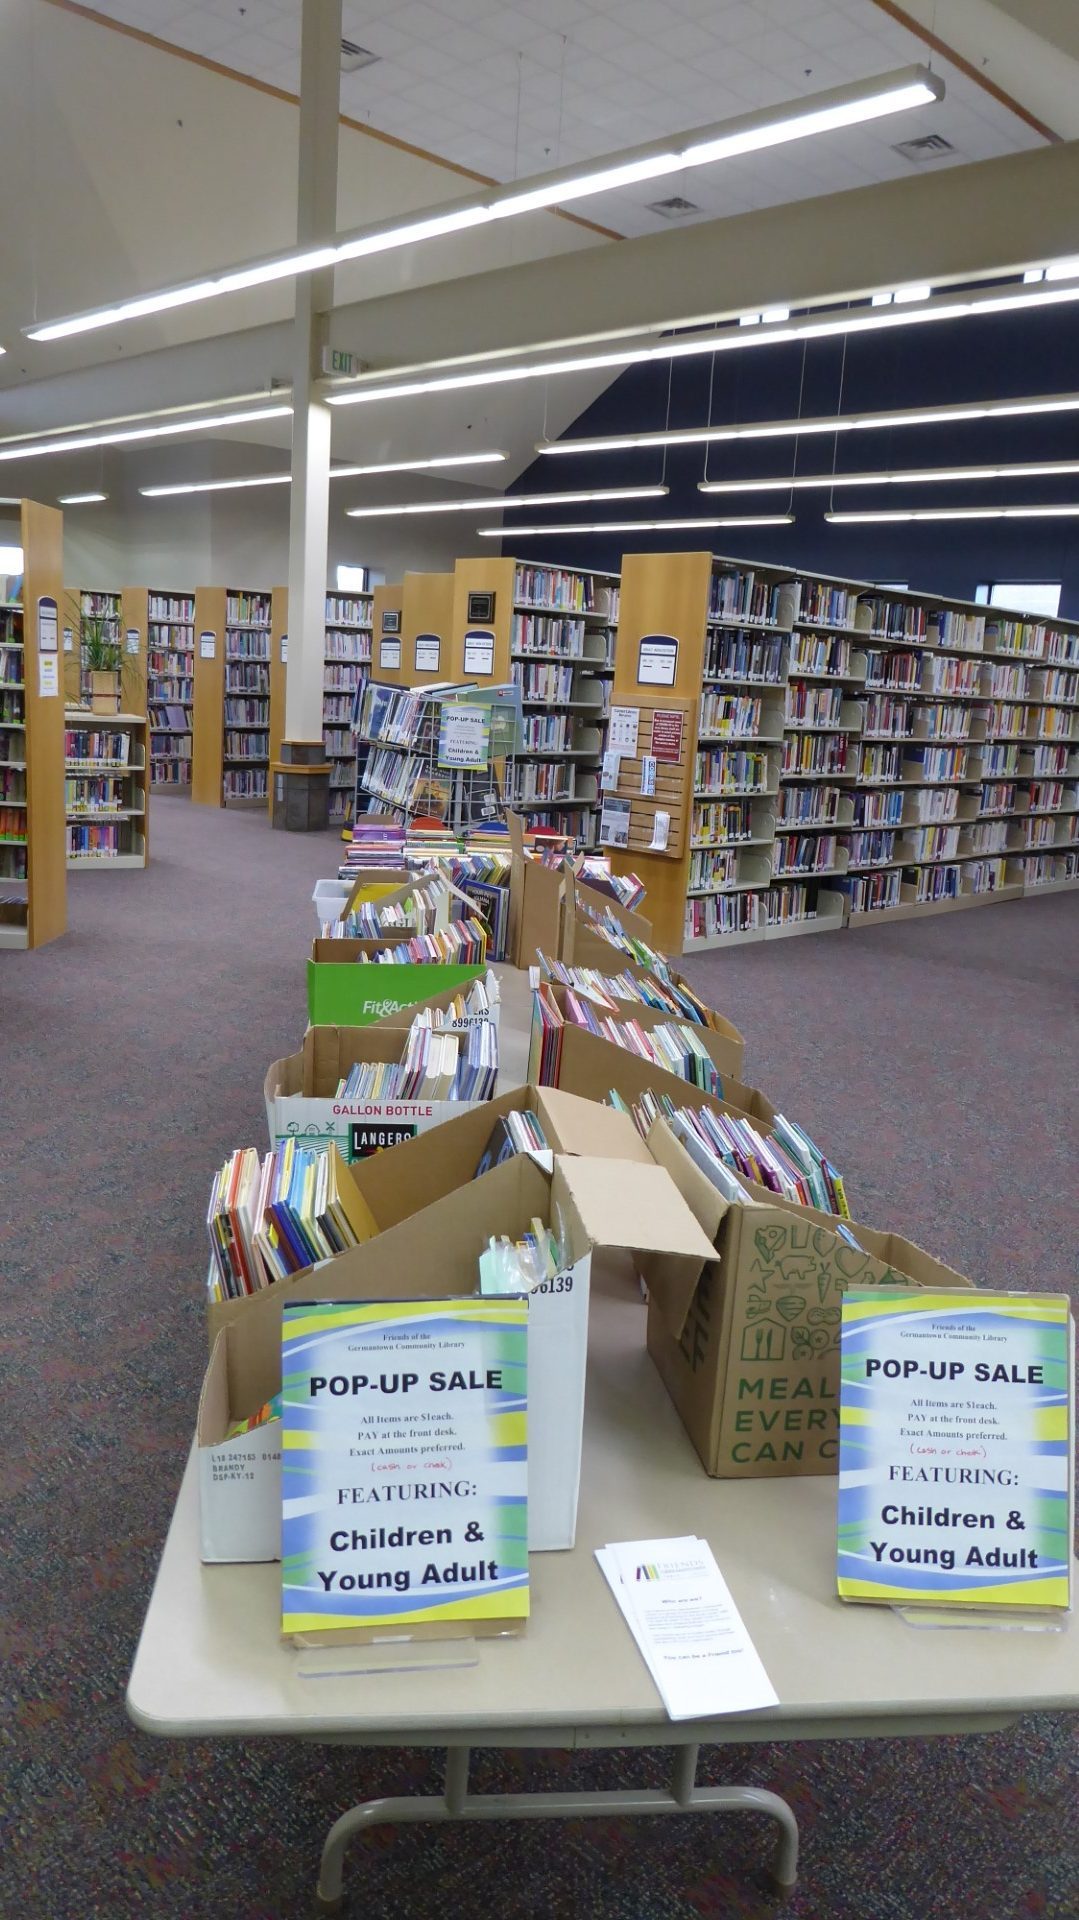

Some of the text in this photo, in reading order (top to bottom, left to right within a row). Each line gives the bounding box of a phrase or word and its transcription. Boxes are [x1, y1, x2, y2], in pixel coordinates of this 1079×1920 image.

[332, 350, 352, 374] EXIT
[332, 1104, 432, 1116] GALLON BOTTLE
[395, 1342, 436, 1351] Community
[438, 1341, 465, 1349] Library
[900, 1331, 1007, 1342] Germantown Community Library
[866, 1359, 1044, 1384] POP-UP SALE
[310, 1370, 503, 1397] POP-UP SALE
[738, 1378, 835, 1400] MEAL
[925, 1400, 948, 1408] Items
[360, 1416, 374, 1424] All
[377, 1415, 401, 1424] Items
[908, 1414, 927, 1422] PAY
[956, 1416, 976, 1424] front
[978, 1416, 1000, 1425] desk.
[358, 1431, 378, 1440] PAY
[393, 1430, 407, 1438] the
[409, 1428, 432, 1437] front
[434, 1427, 457, 1436] desk.
[900, 1428, 1007, 1440] Exact Amounts preferred.
[350, 1442, 466, 1456] Exact Amounts preferred.
[731, 1441, 804, 1463] CAN
[888, 1465, 1019, 1487] FEATURING:
[337, 1481, 478, 1505] FEATURING:
[881, 1505, 1025, 1530] Children &
[330, 1522, 485, 1552] Children &
[870, 1542, 1038, 1570] Young Adult
[318, 1560, 499, 1592] Young Adult
